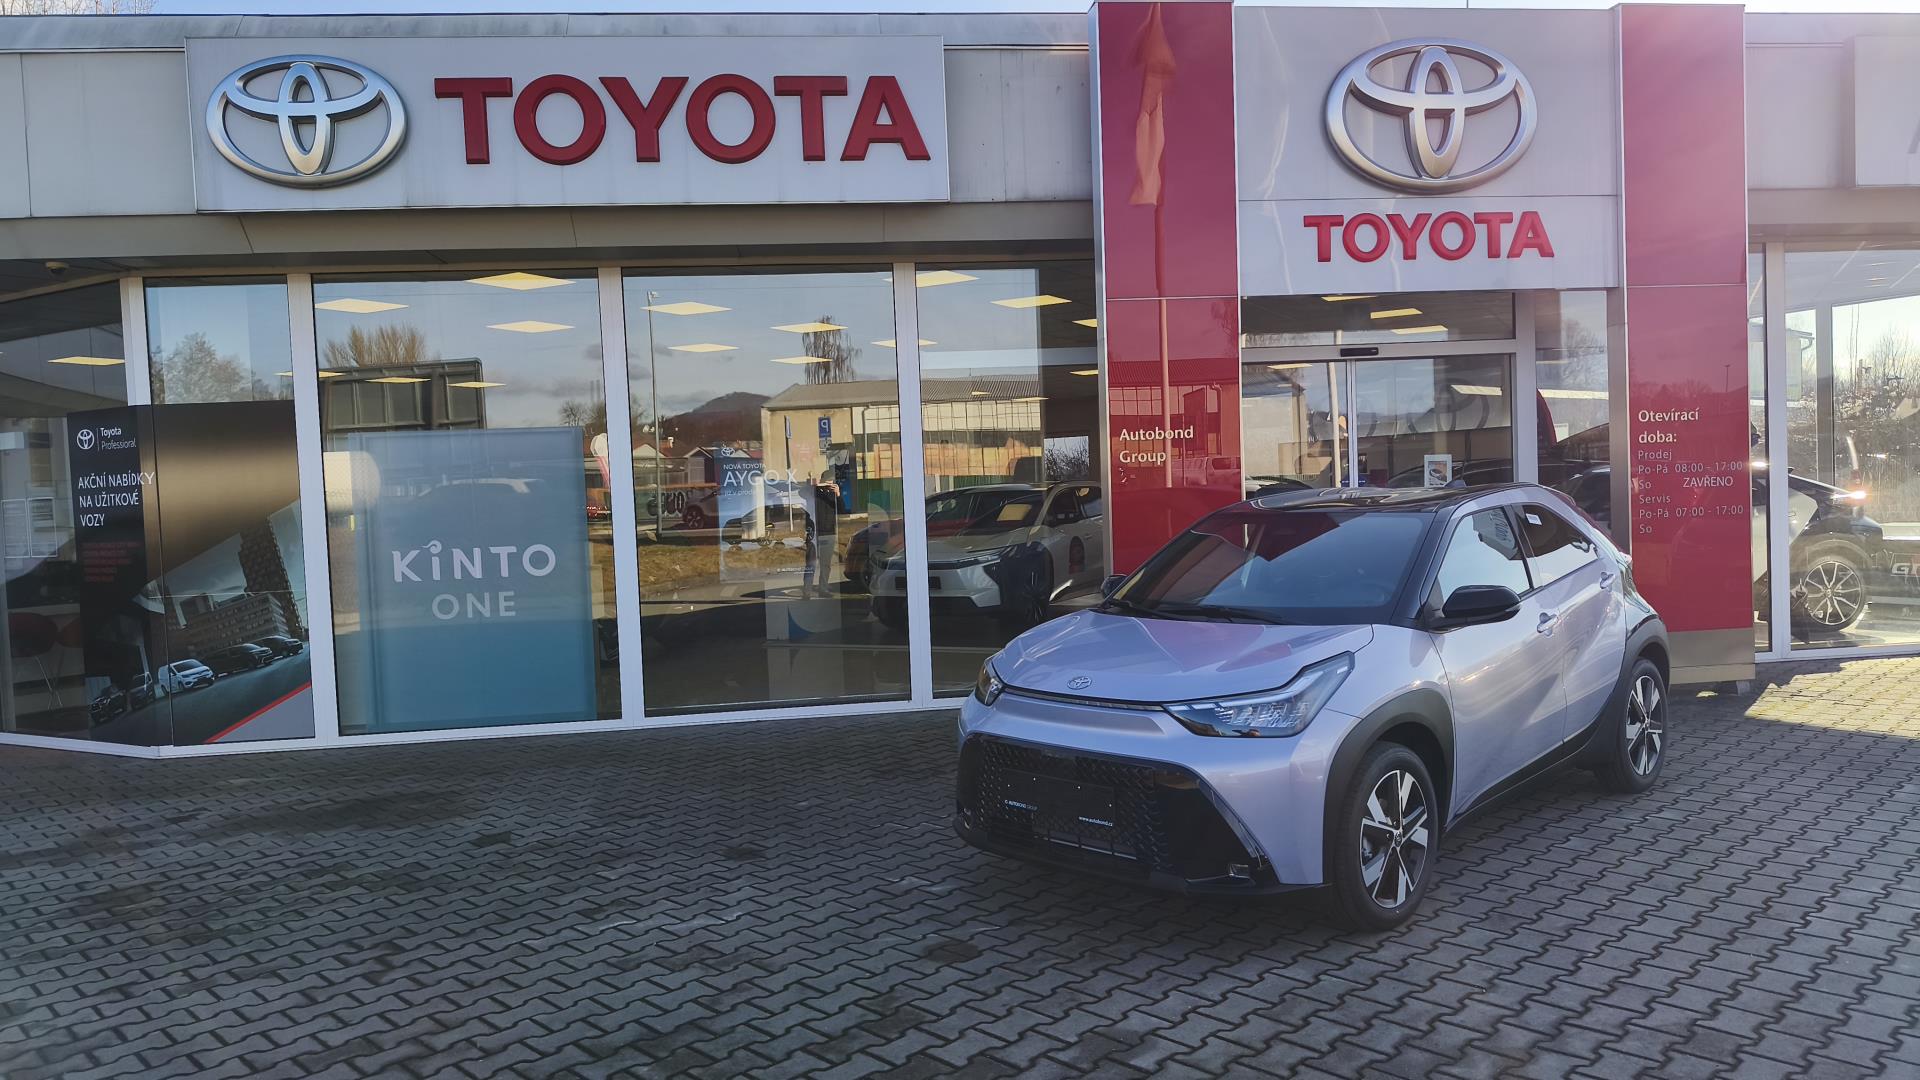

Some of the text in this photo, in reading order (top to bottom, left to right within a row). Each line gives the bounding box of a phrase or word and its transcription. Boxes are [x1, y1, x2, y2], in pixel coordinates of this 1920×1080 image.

[435, 74, 931, 165] TOYOTA
[1303, 211, 1555, 263] TOYOTA
[1638, 407, 1700, 422] Otevírací
[100, 427, 122, 438] Toyota
[1119, 425, 1194, 441] Autobond
[1638, 430, 1677, 443] doba:
[101, 437, 137, 450] Professional
[1119, 450, 1167, 465] Group
[1638, 449, 1672, 460] Prodej
[1638, 464, 1668, 474] Po-Pá
[1674, 462, 1704, 473] 08:00
[1715, 461, 1743, 471] 17:00
[78, 469, 155, 489] AKČNÍ NABÍDKY
[723, 468, 799, 487] AYGO X
[1639, 475, 1734, 490] So ZAVŘENO
[80, 488, 139, 508] NA UŽITKOVÉ
[1639, 494, 1671, 504] Servis
[1639, 508, 1669, 519] Po-Pá
[1676, 507, 1705, 517] 07:00
[1716, 505, 1744, 515] 17:00
[80, 513, 105, 527] VOZY
[1639, 524, 1652, 534] So
[432, 590, 516, 620] ONE
